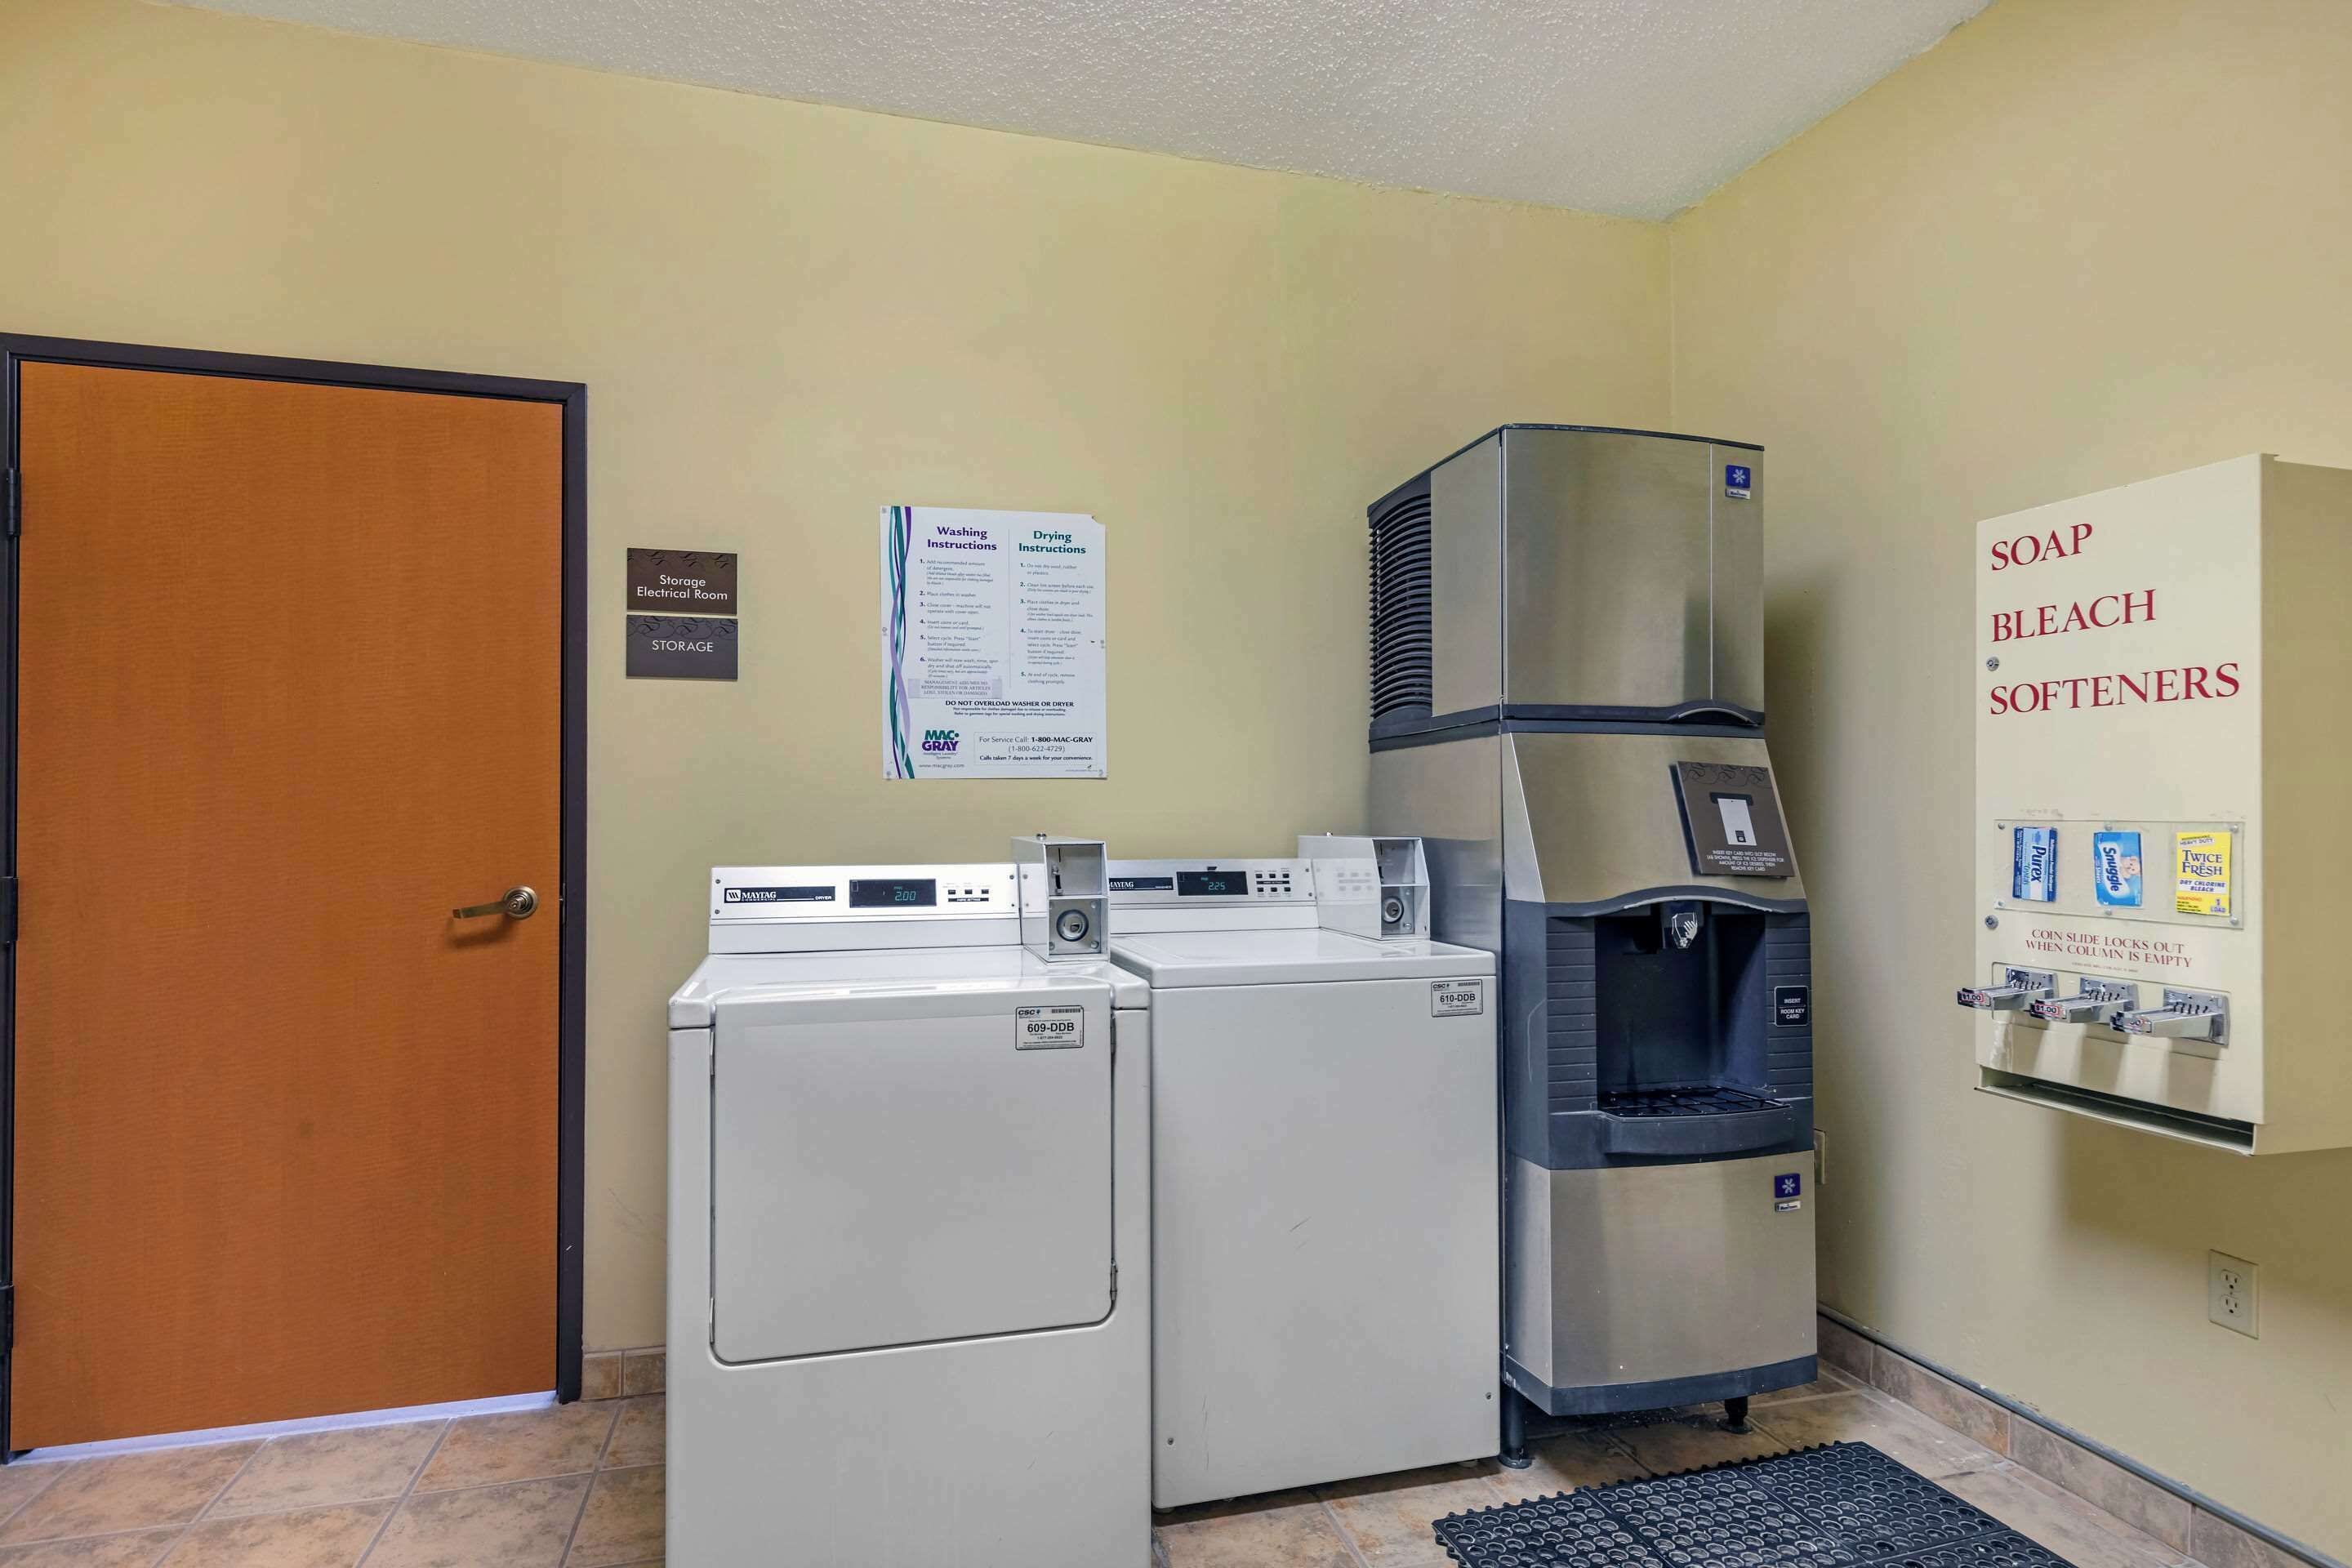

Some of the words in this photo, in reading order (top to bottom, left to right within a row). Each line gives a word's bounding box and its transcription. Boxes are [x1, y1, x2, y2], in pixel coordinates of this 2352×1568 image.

[937, 526, 988, 540] Washing
[1033, 530, 1072, 543] Drying
[927, 539, 997, 550] Instructions
[1019, 543, 1086, 554] Instructions
[1991, 523, 2093, 571] SOAP
[660, 575, 706, 588] Storage
[637, 587, 690, 598] Electrical
[695, 590, 727, 600] Room
[1991, 589, 2156, 642] BLEACH
[652, 640, 713, 652] STORAGE
[1990, 663, 2240, 715] SOFTENERS
[922, 741, 958, 751] GRAY
[2031, 846, 2046, 882] Purex
[2103, 847, 2123, 891] Snuggle
[2032, 929, 2062, 940] COIN
[2067, 932, 2100, 945] SLIDE
[2105, 936, 2149, 950] LOCKS
[2153, 941, 2184, 954] OUT
[2025, 940, 2063, 952] WHEN
[2067, 944, 2123, 959] COLUMN
[2129, 951, 2139, 962] IS
[2145, 953, 2191, 967] EMPTY
[1440, 993, 1475, 1002] 610-DDB
[2035, 1005, 2057, 1013] $1.00
[1028, 1022, 1074, 1033] 609-DDB
